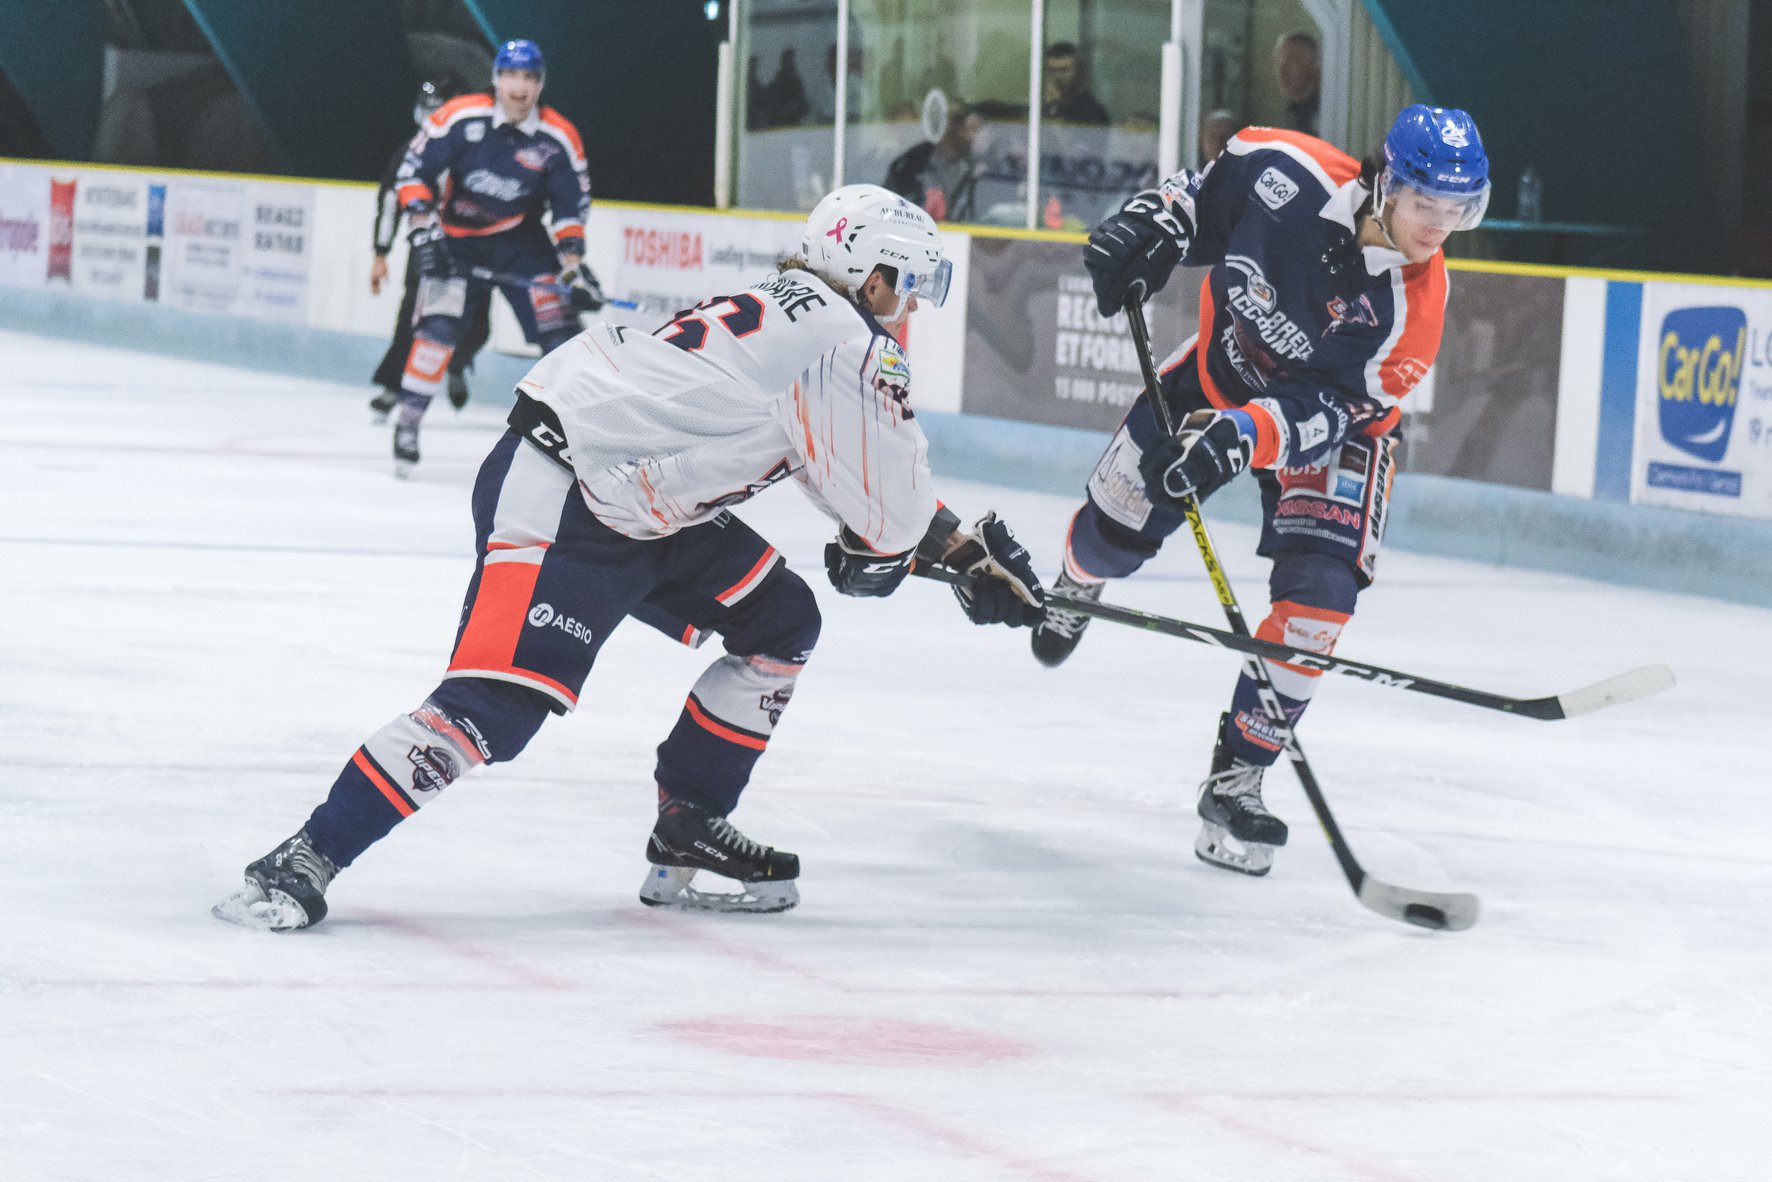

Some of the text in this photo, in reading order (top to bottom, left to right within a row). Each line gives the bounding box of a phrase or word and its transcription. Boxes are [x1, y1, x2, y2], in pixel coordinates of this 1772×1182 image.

[623, 228, 703, 270] TOSHIBA
[880, 248, 909, 261] CCM
[1274, 500, 1361, 530] NISSAN
[1286, 652, 1415, 690] CCM
[694, 840, 729, 861] CCM
